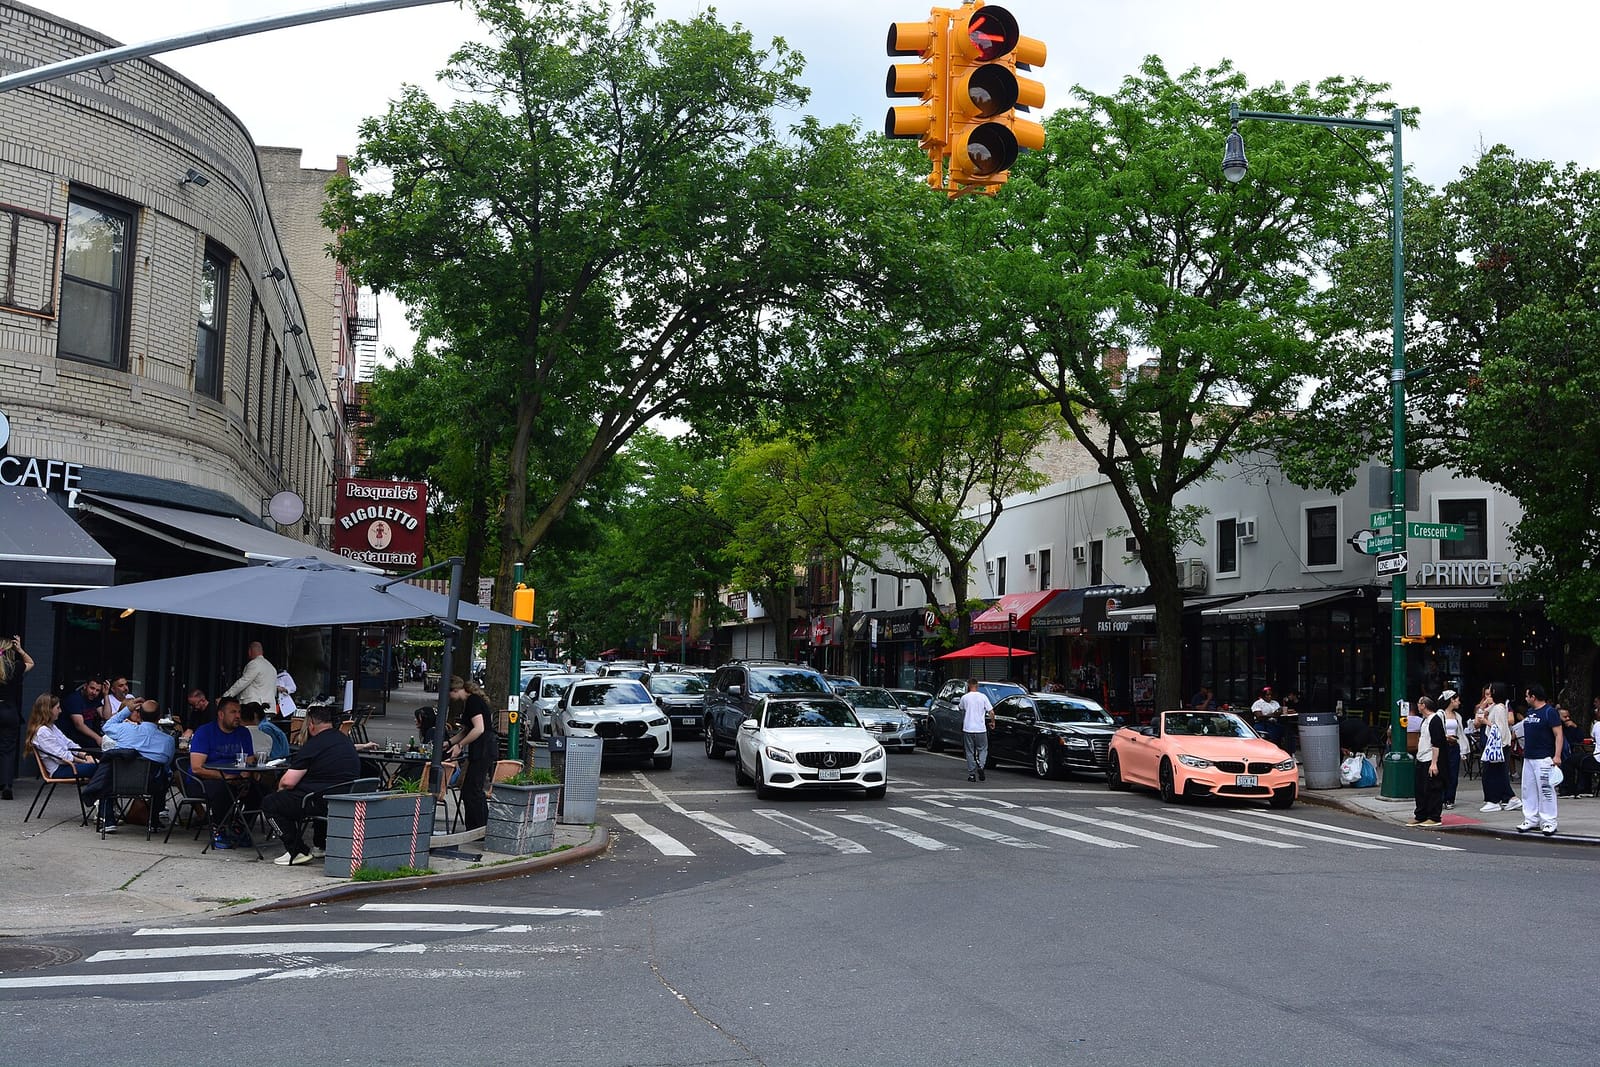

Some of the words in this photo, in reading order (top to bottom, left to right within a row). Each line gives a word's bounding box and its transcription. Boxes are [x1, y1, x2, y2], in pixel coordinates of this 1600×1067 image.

[0, 456, 83, 493] CAFE
[346, 482, 418, 500] Pasquale's
[340, 505, 418, 530] RIGOLETTO
[1373, 514, 1387, 527] Arthur
[1414, 524, 1448, 538] Crescent
[340, 547, 417, 565] Restaurant
[1379, 561, 1389, 570] ONE
[1393, 558, 1404, 568] WAY
[1421, 562, 1503, 586] PRINCE
[1097, 621, 1112, 632] FAST
[1113, 621, 1128, 632] FOOD
